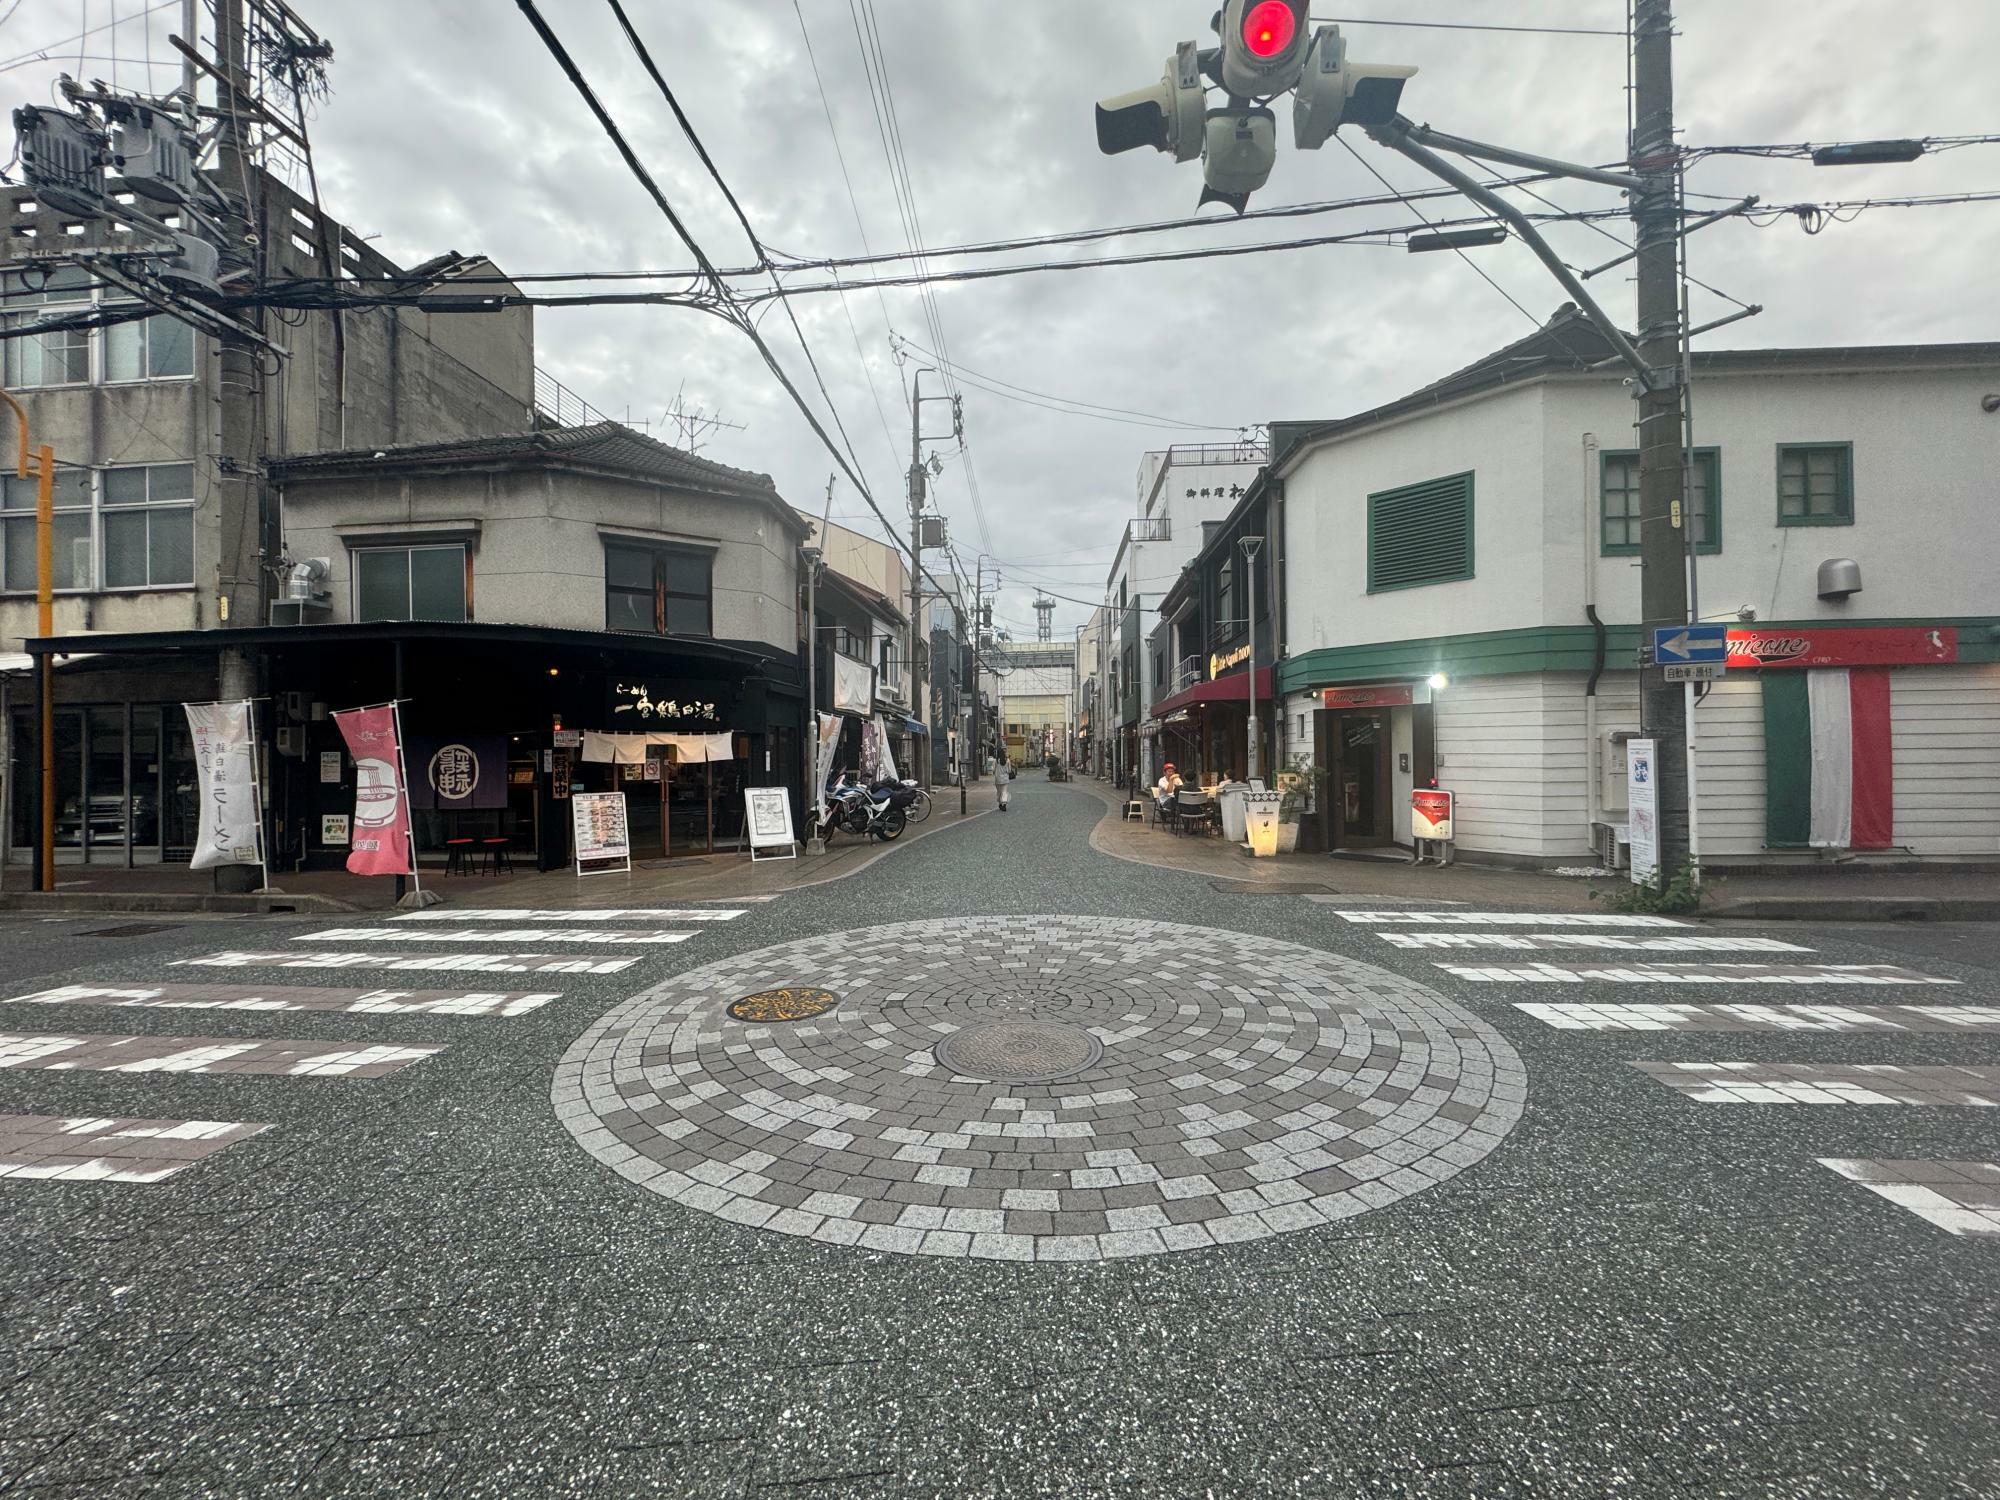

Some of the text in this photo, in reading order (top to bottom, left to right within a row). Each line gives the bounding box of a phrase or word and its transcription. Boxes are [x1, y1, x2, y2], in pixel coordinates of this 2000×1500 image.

[616, 683, 648, 696] らーめん
[614, 696, 716, 719] 一宮鶏白湯
